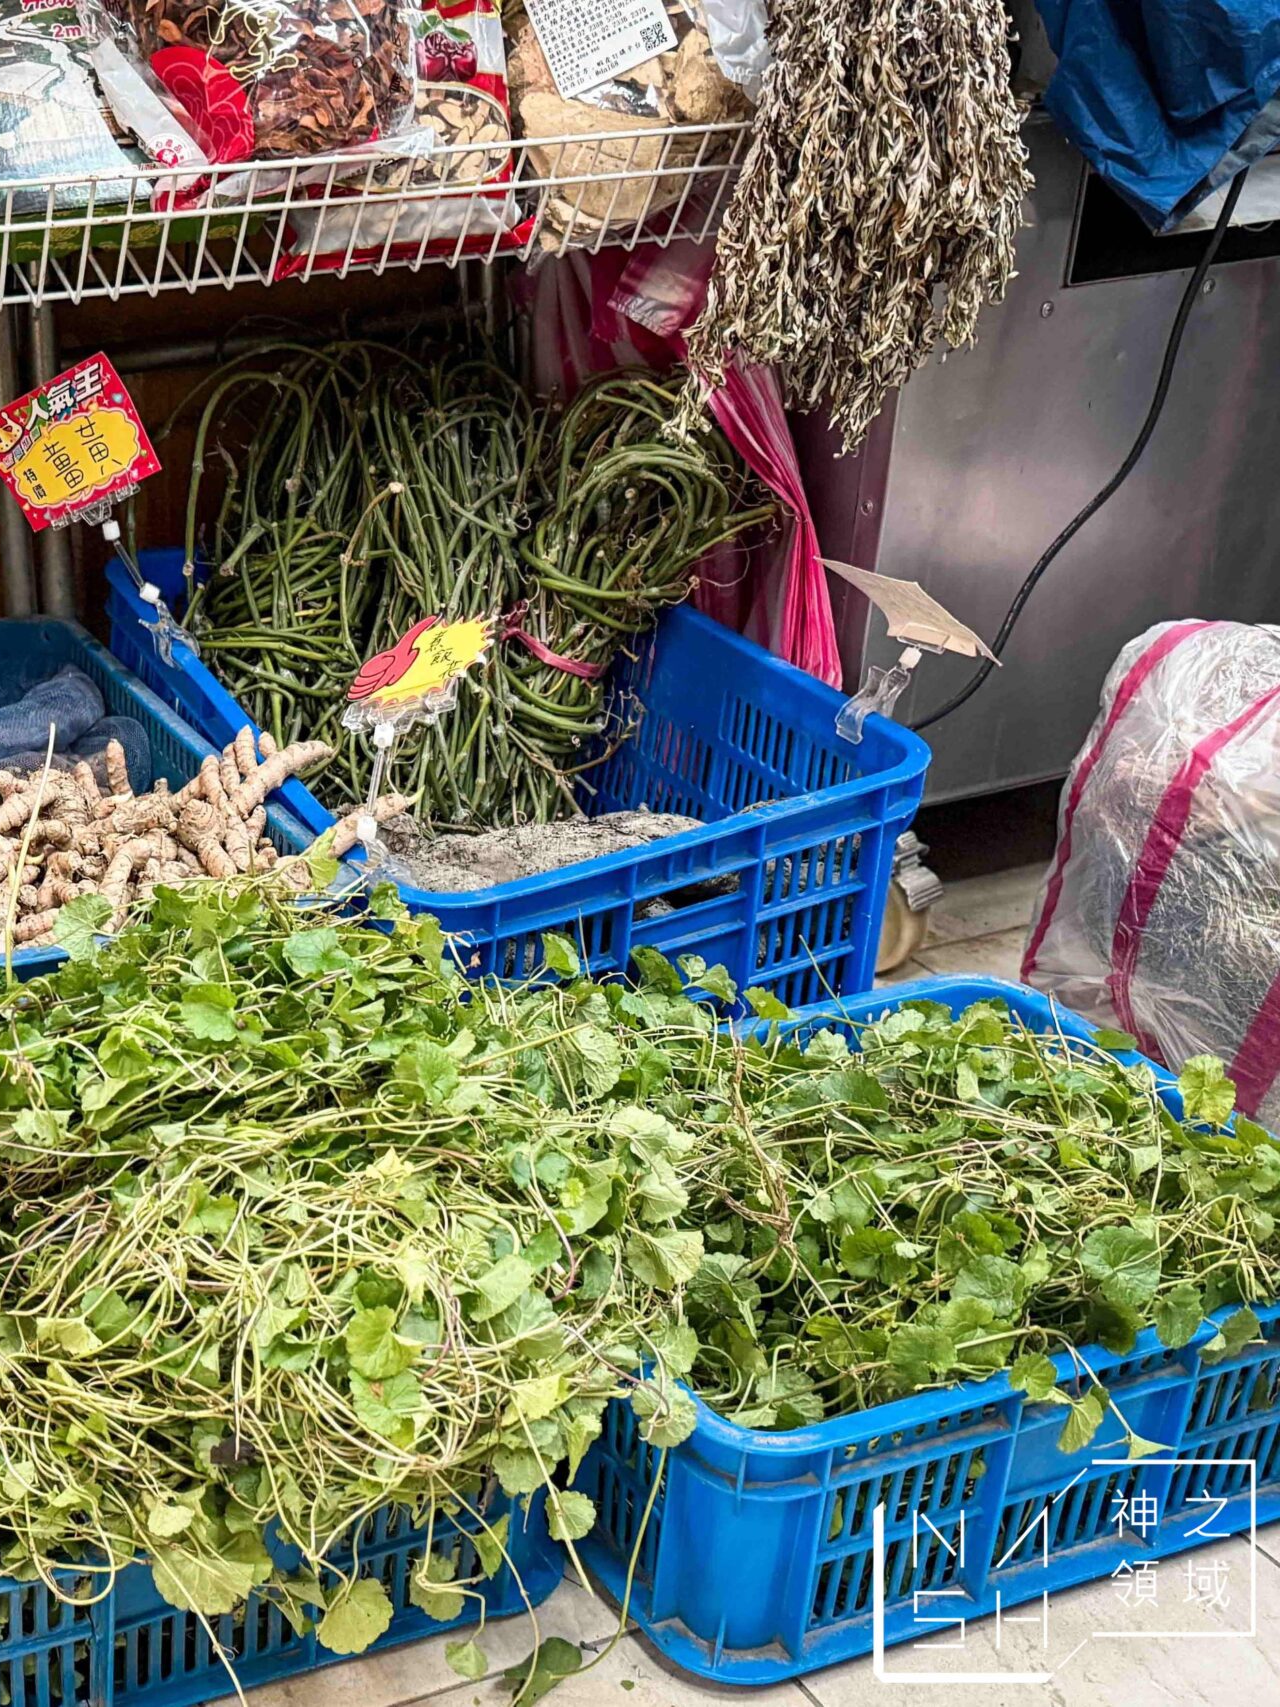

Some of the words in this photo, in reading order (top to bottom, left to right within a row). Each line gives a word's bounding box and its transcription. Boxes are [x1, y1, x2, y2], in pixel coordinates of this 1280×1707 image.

[26, 362, 104, 431] 人氣王
[22, 467, 47, 500] 特價
